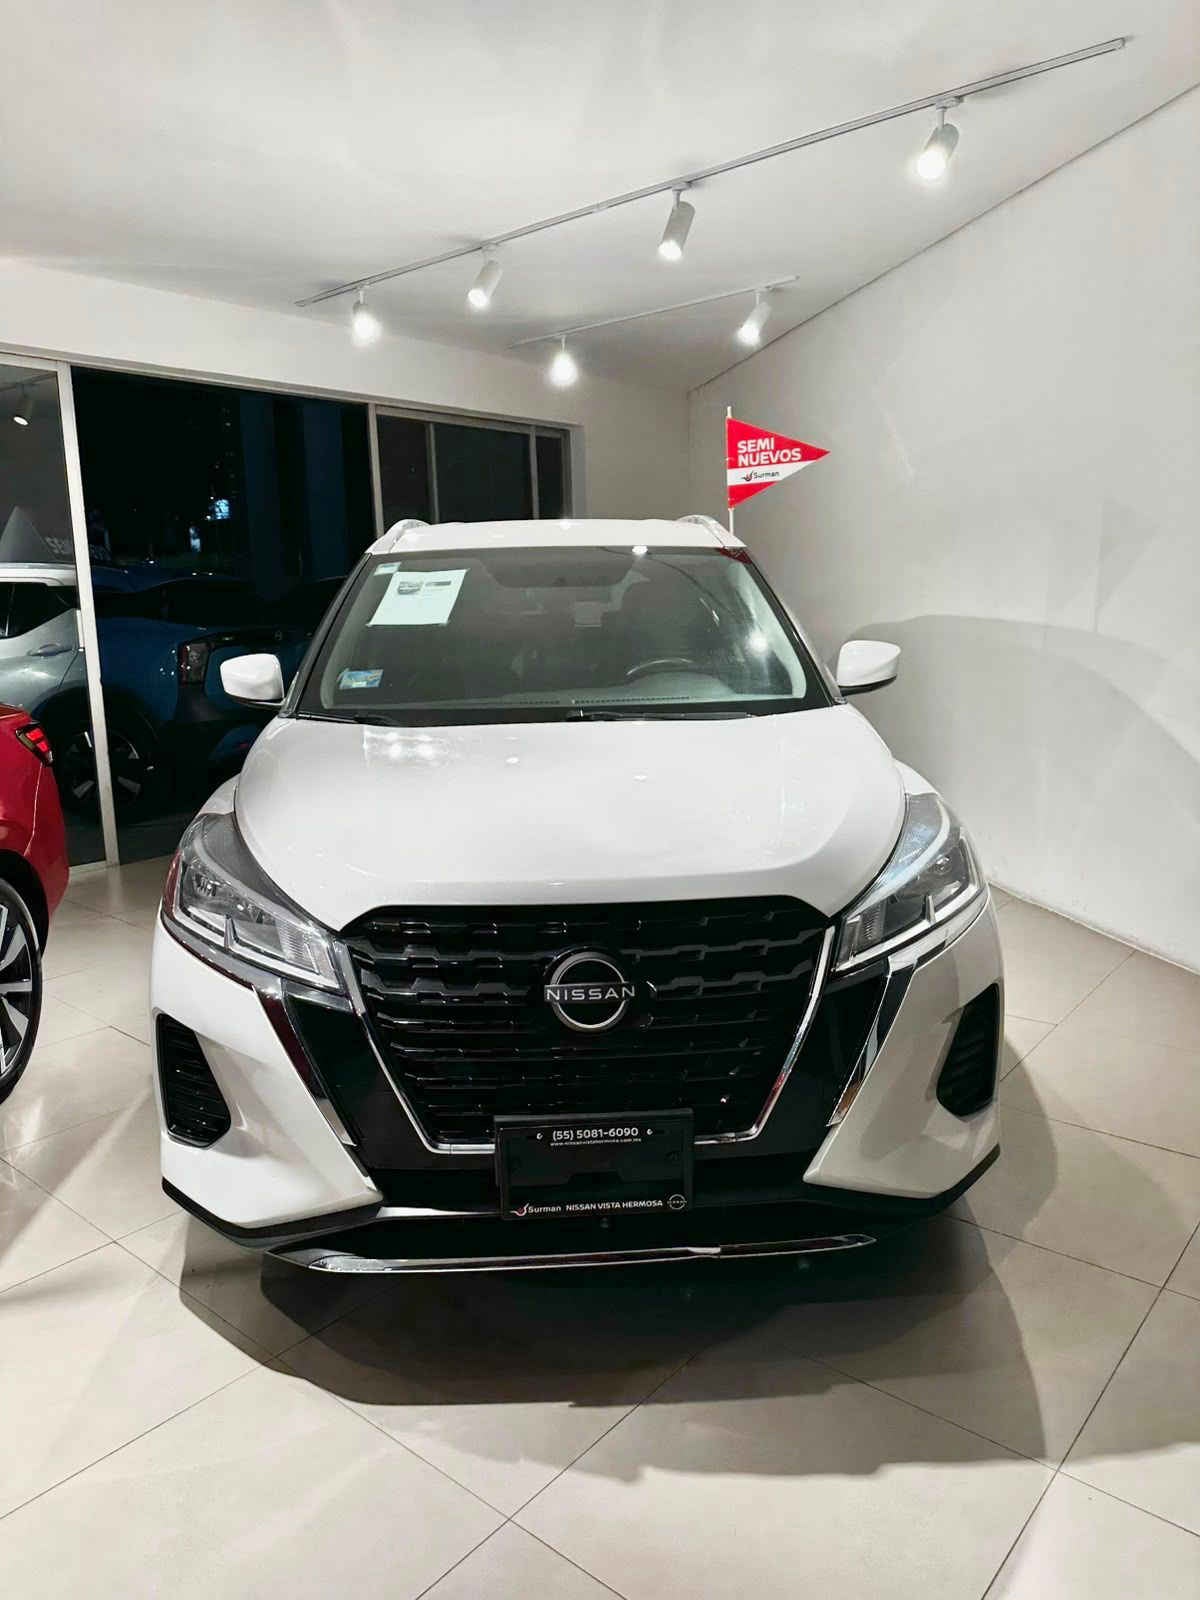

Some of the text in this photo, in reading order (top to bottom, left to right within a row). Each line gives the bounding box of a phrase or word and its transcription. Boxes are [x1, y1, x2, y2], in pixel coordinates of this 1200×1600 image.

[737, 437, 775, 453] SEMI
[737, 448, 802, 466] NUEVOS
[753, 471, 780, 479] Surman
[546, 985, 635, 1001] NISSAN
[552, 1127, 639, 1141] (55) 5081-6090
[528, 1205, 562, 1214] Surman
[566, 1203, 597, 1211] NISSAN
[597, 1201, 621, 1210] VISTA
[622, 1199, 663, 1209] HERMOSA
